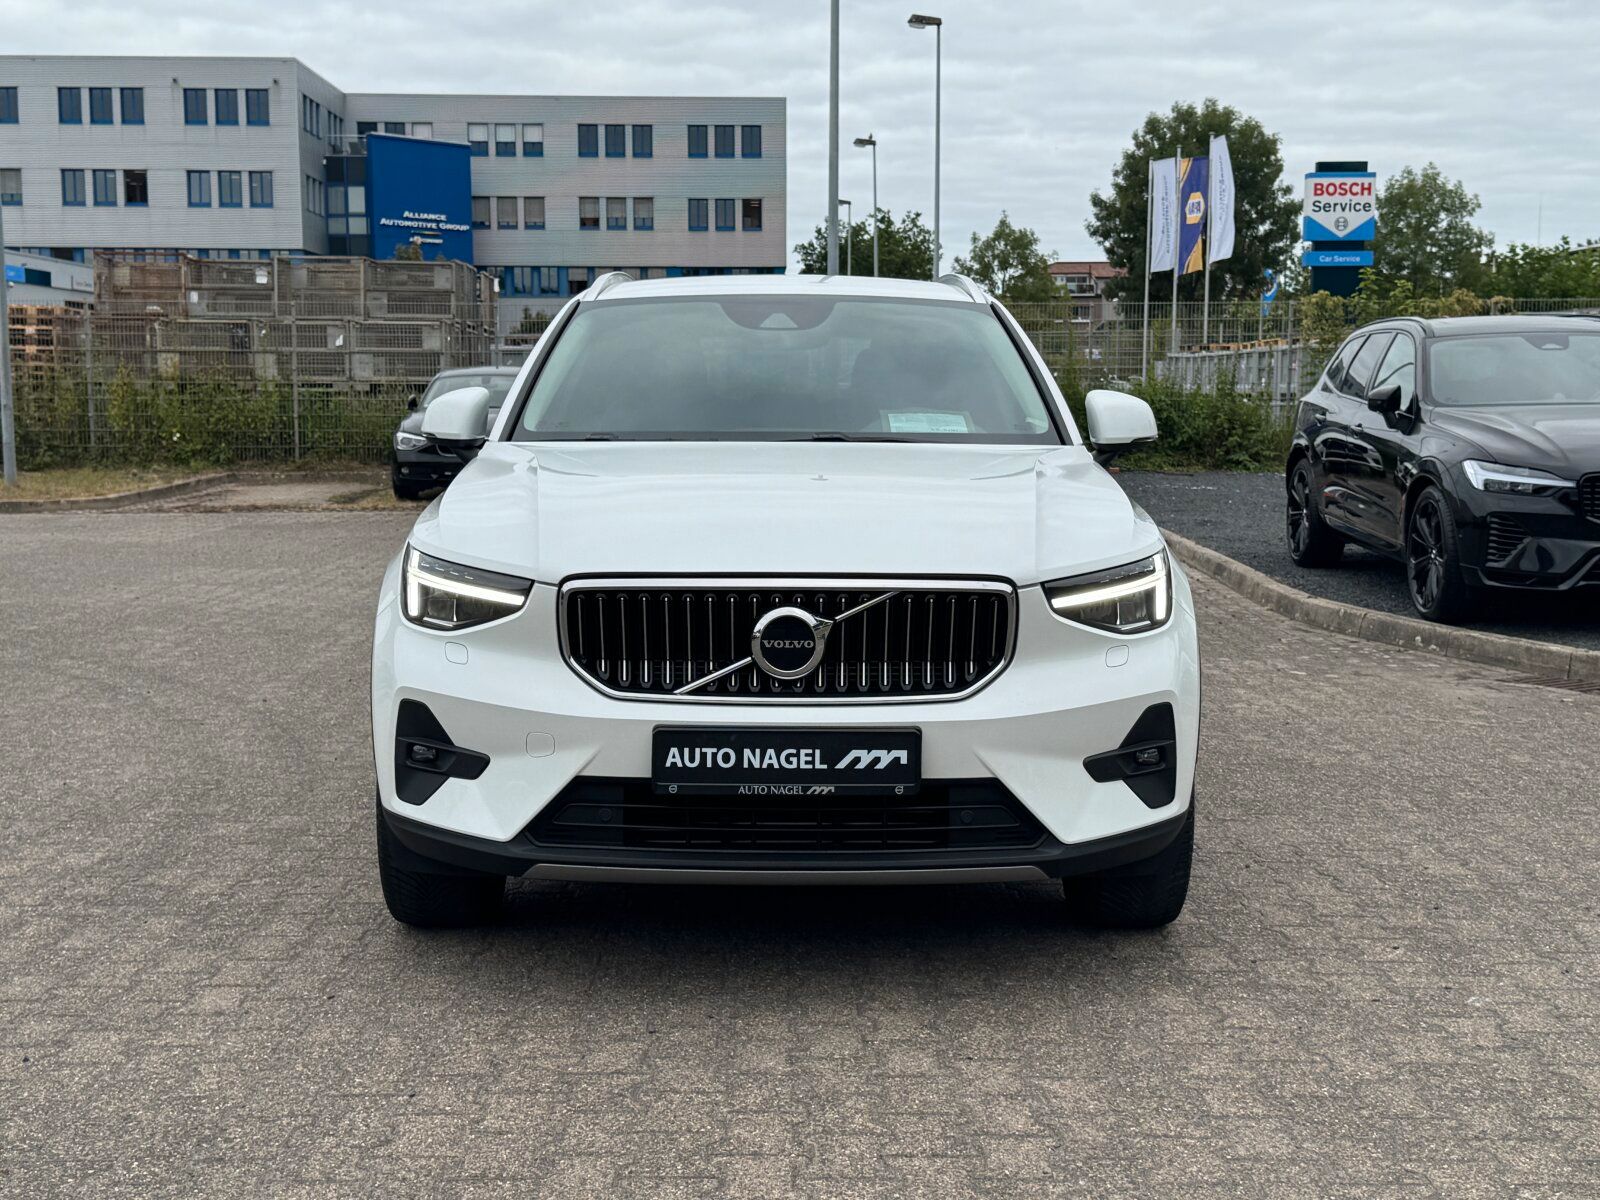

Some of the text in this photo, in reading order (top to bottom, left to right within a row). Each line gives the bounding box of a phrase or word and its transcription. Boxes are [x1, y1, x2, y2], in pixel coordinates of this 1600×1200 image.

[1313, 182, 1372, 196] BOSCH
[1312, 199, 1371, 212] Service
[1319, 255, 1361, 263] Car Service
[762, 640, 814, 649] VOLVO
[665, 747, 828, 769] AUTO NAGEL
[738, 785, 804, 795] AUTO NAGEL
